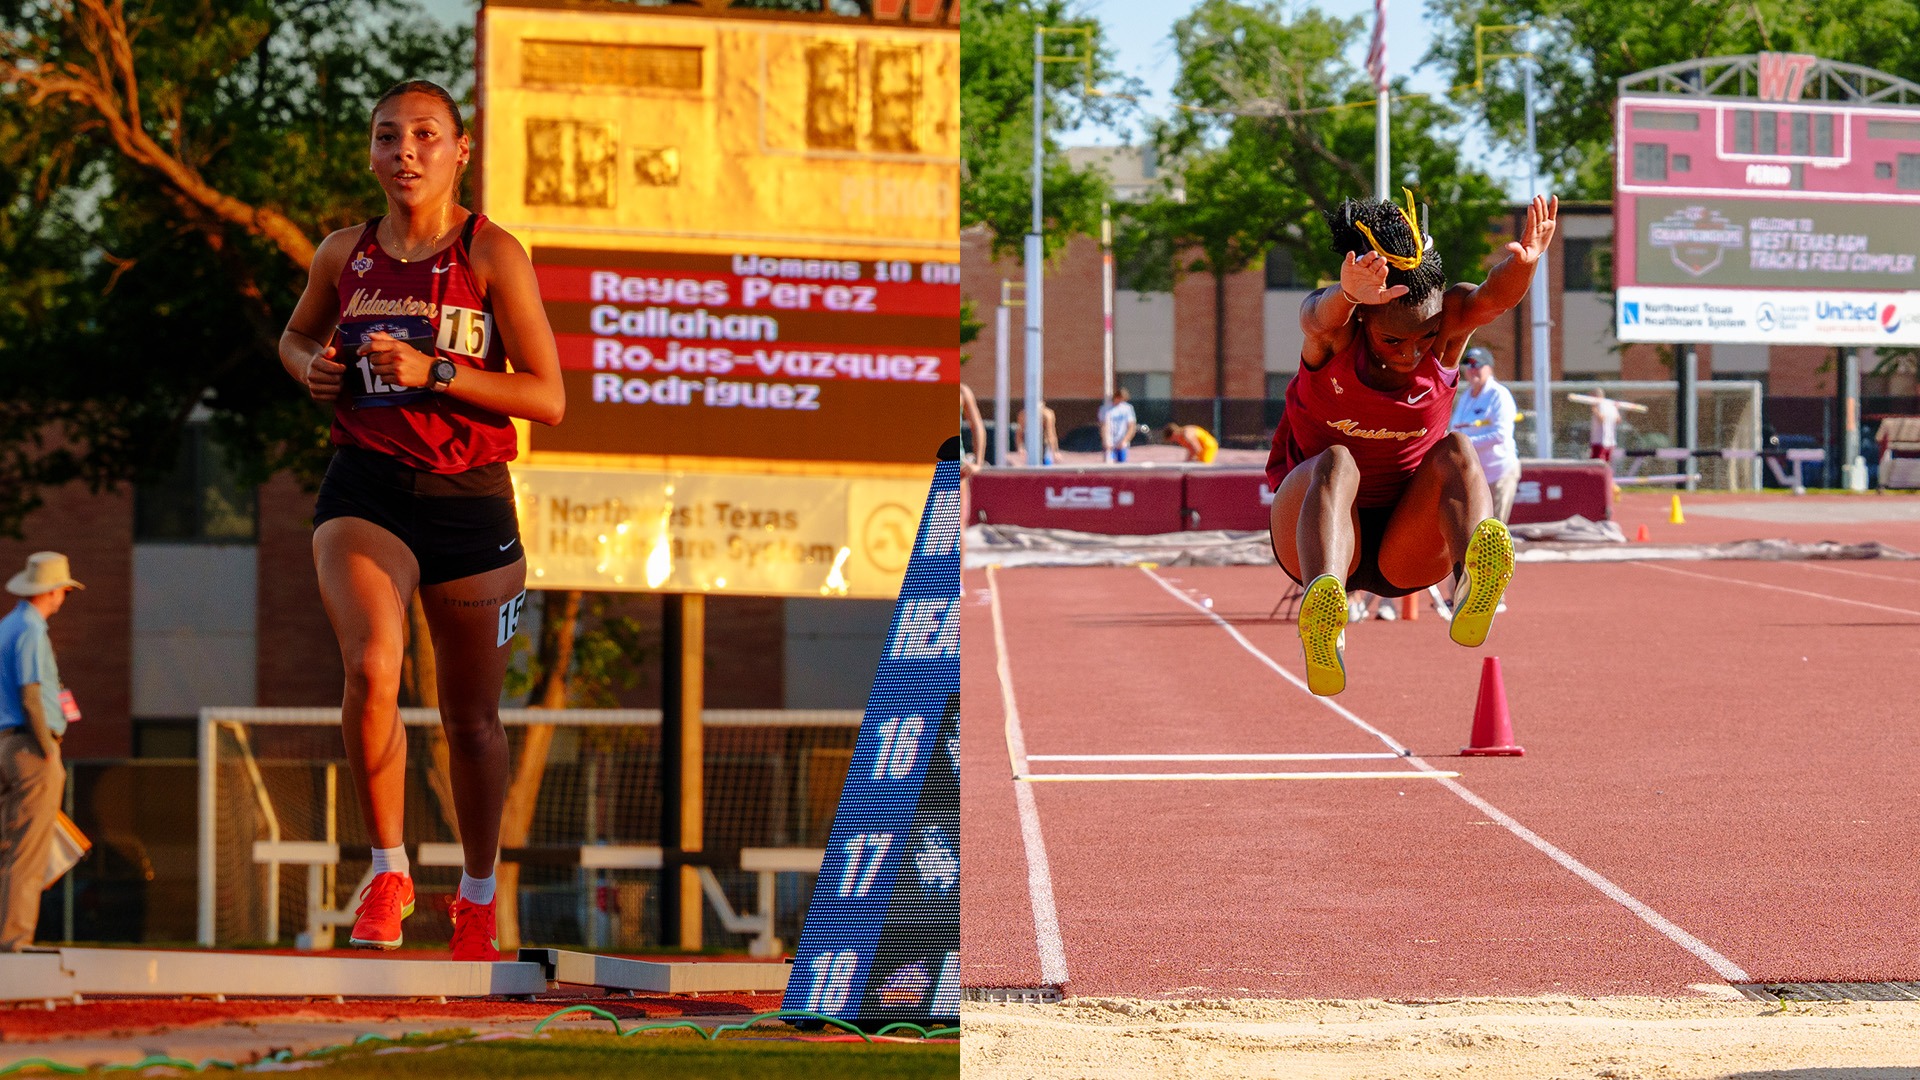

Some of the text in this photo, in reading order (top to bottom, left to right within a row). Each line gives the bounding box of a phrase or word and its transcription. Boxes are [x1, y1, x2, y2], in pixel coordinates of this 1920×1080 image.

[1759, 51, 1816, 101] WT
[732, 254, 861, 280] Womens
[874, 260, 912, 282] 10
[343, 288, 439, 319] Midwestern
[590, 271, 877, 312] Reyes Perez
[590, 304, 778, 341] Callahan
[1816, 301, 1877, 320] United
[446, 308, 486, 354] 15
[592, 373, 821, 410] Rodriguez
[1045, 486, 1113, 506] UCS
[714, 502, 799, 530] Texas
[451, 598, 498, 608] TIMOTHY
[872, 714, 925, 780] 16
[839, 834, 893, 897] 17
[805, 949, 858, 1015] 18
